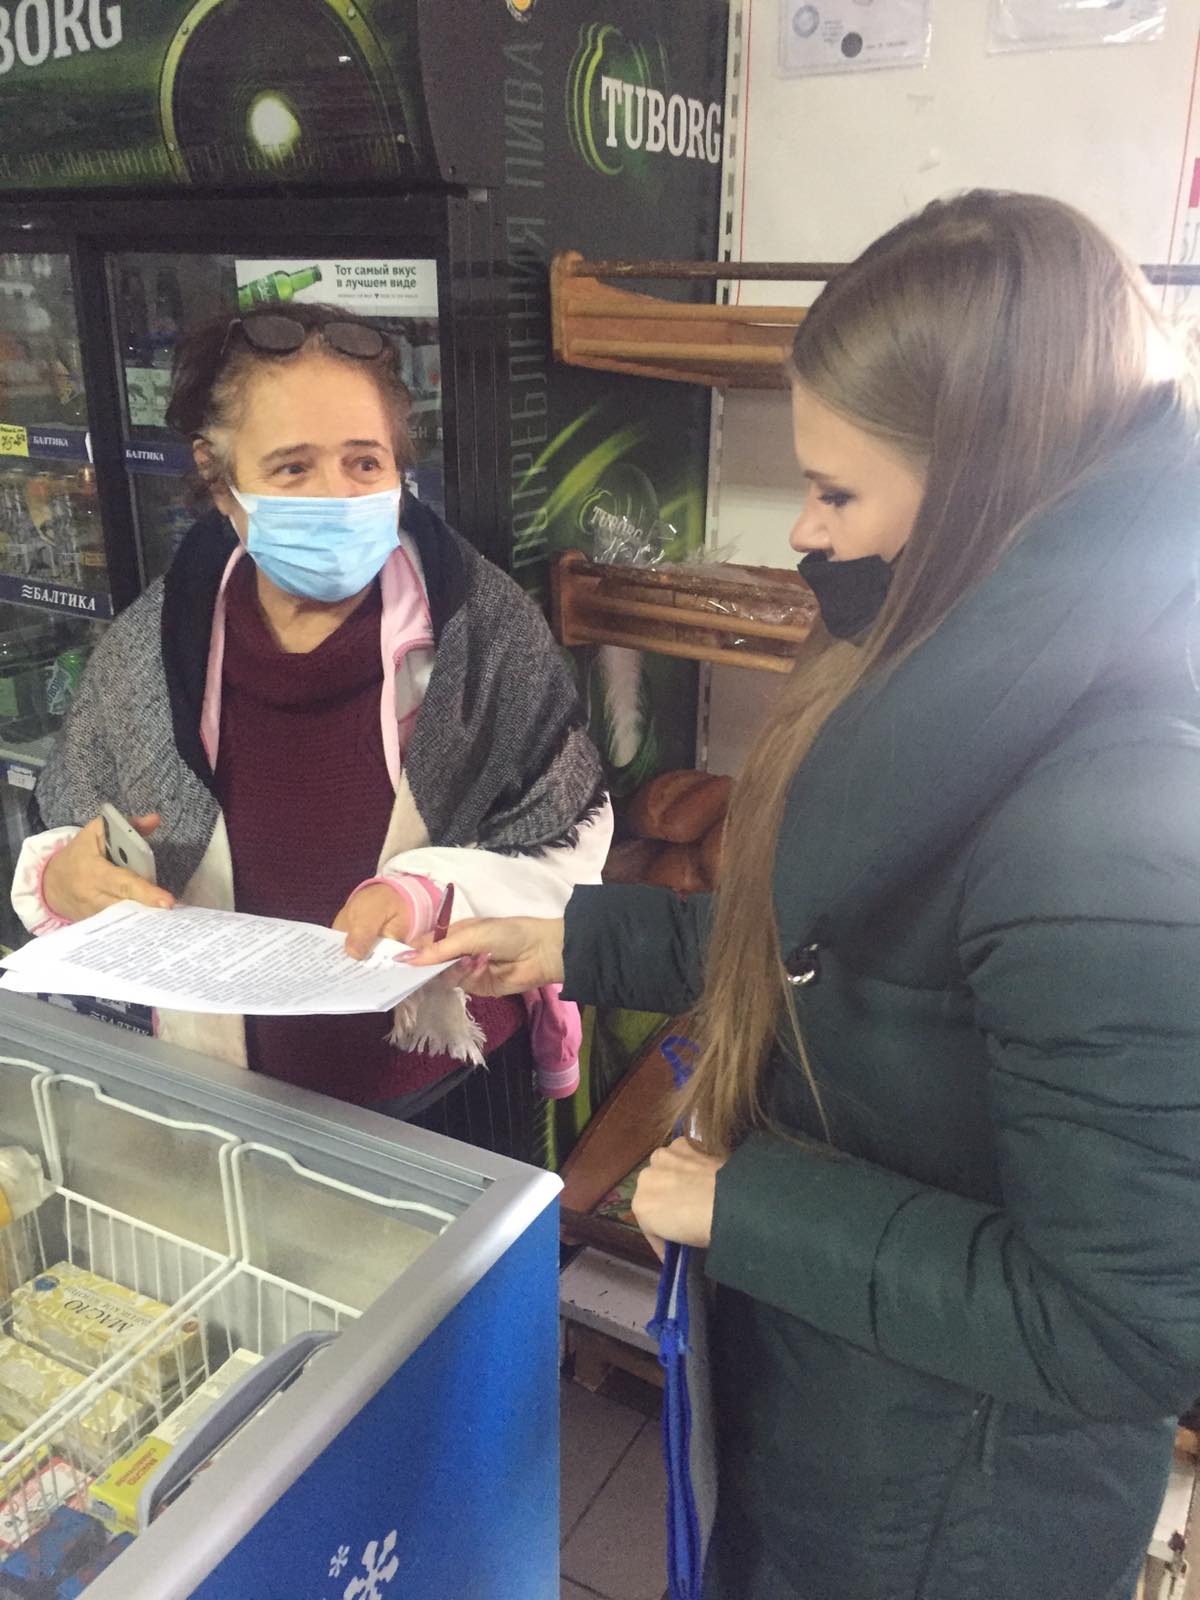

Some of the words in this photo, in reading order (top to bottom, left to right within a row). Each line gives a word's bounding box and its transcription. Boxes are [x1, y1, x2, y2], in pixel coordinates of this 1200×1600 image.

[503, 42, 545, 188] ПИВА
[601, 75, 722, 164] TUBORG
[335, 264, 351, 276] Тот
[355, 264, 389, 276] самый
[392, 266, 417, 278] вкус
[336, 280, 342, 288] в
[345, 279, 387, 290] лучшем
[390, 279, 417, 289] виде
[33, 435, 69, 447] БАЛТИКА
[126, 449, 165, 462] БАЛТИКА
[33, 587, 96, 611] БАЛТИКА
